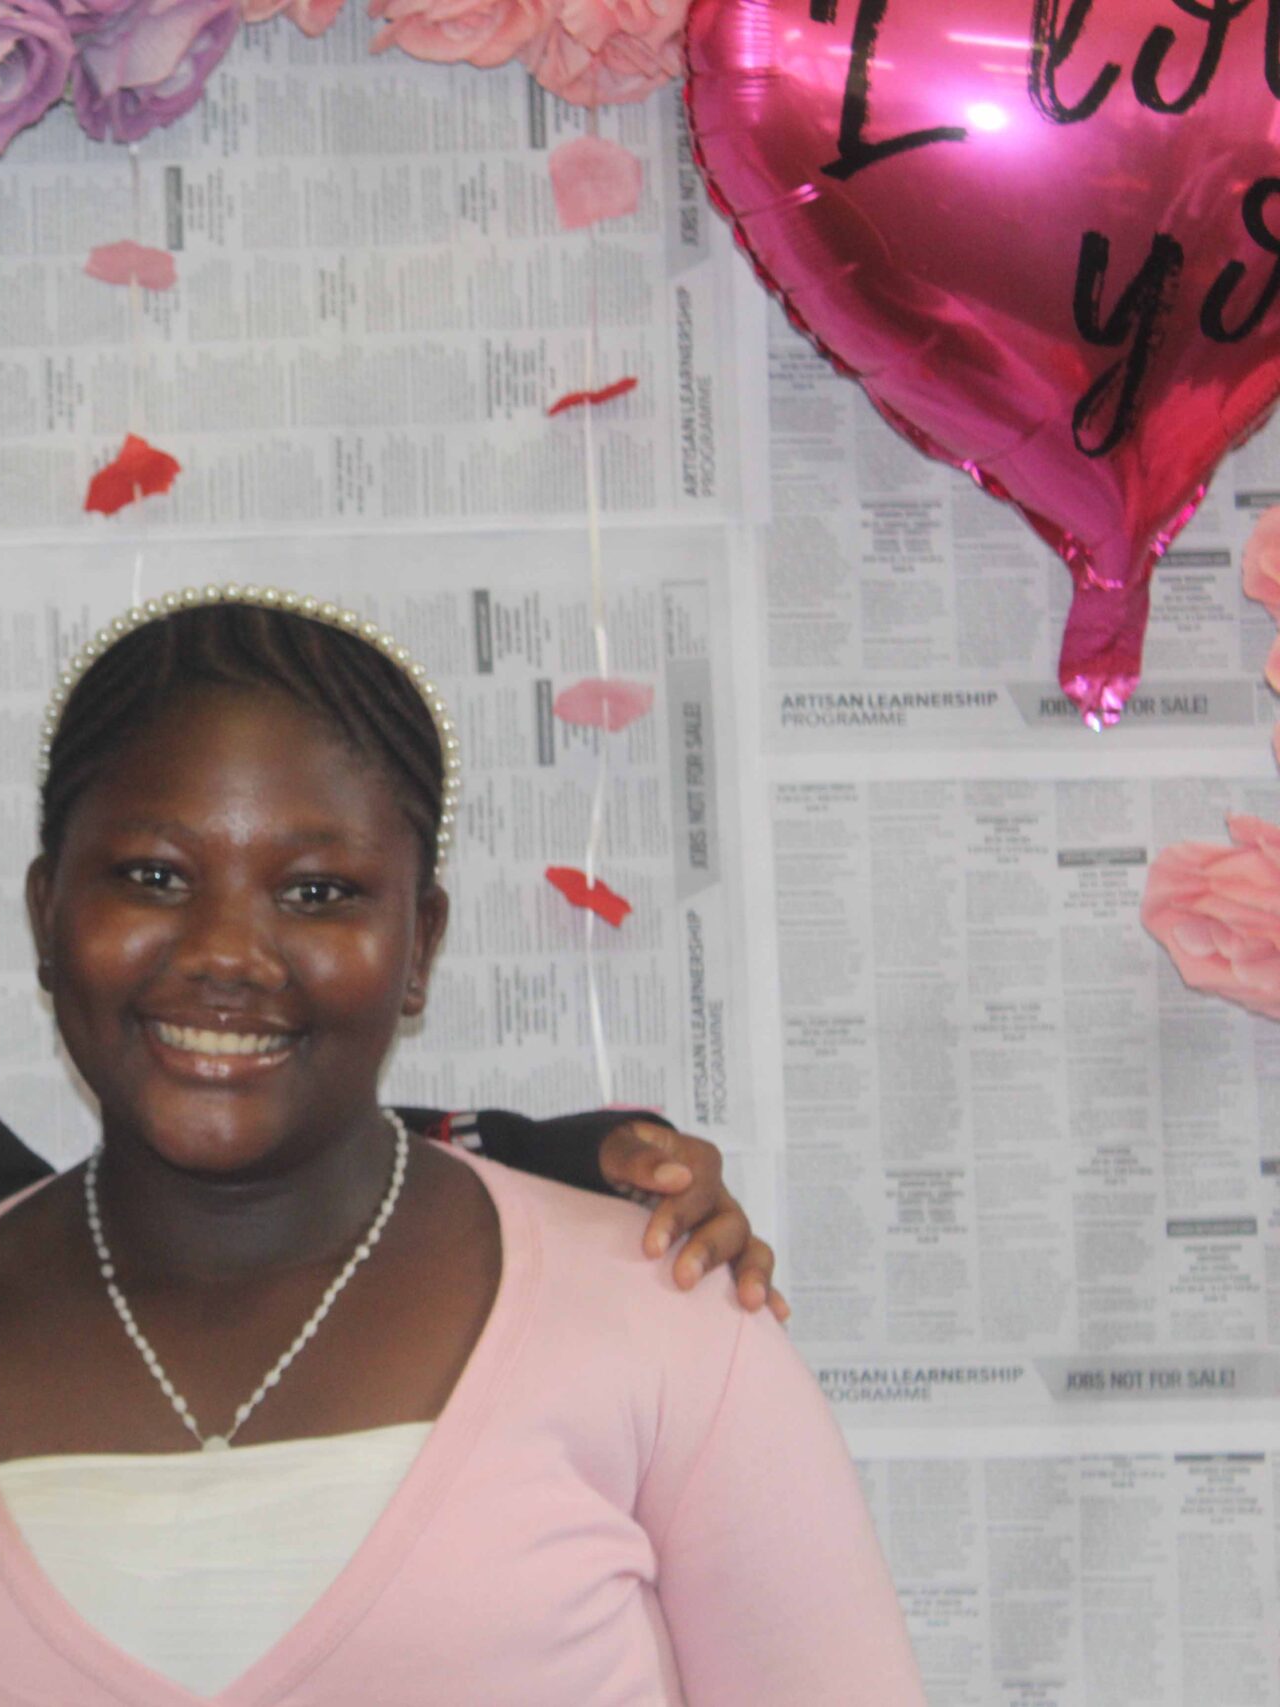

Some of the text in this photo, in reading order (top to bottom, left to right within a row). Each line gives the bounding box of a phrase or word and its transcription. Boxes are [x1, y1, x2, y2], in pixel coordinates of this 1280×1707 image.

[1027, 0, 1280, 124] lo
[676, 286, 697, 497] ARTISAN LEARNERSHIP
[697, 375, 715, 497] PROGRAMME
[781, 690, 998, 709] ARTISAN LEARNERSHIP
[781, 710, 907, 728] PROGRAMME
[1160, 696, 1208, 715] SALE!
[683, 702, 708, 870] JOBS NOT FOR SALE!
[687, 907, 709, 1125] ARTISAN LEARNERSHIP
[709, 1000, 727, 1125] PROGRAMME
[817, 1366, 1024, 1384] RTISAN LEARNERSHIP
[825, 1386, 931, 1402] OGRAMME
[1067, 1369, 1236, 1391] JOBS NOT FOR SALE!
